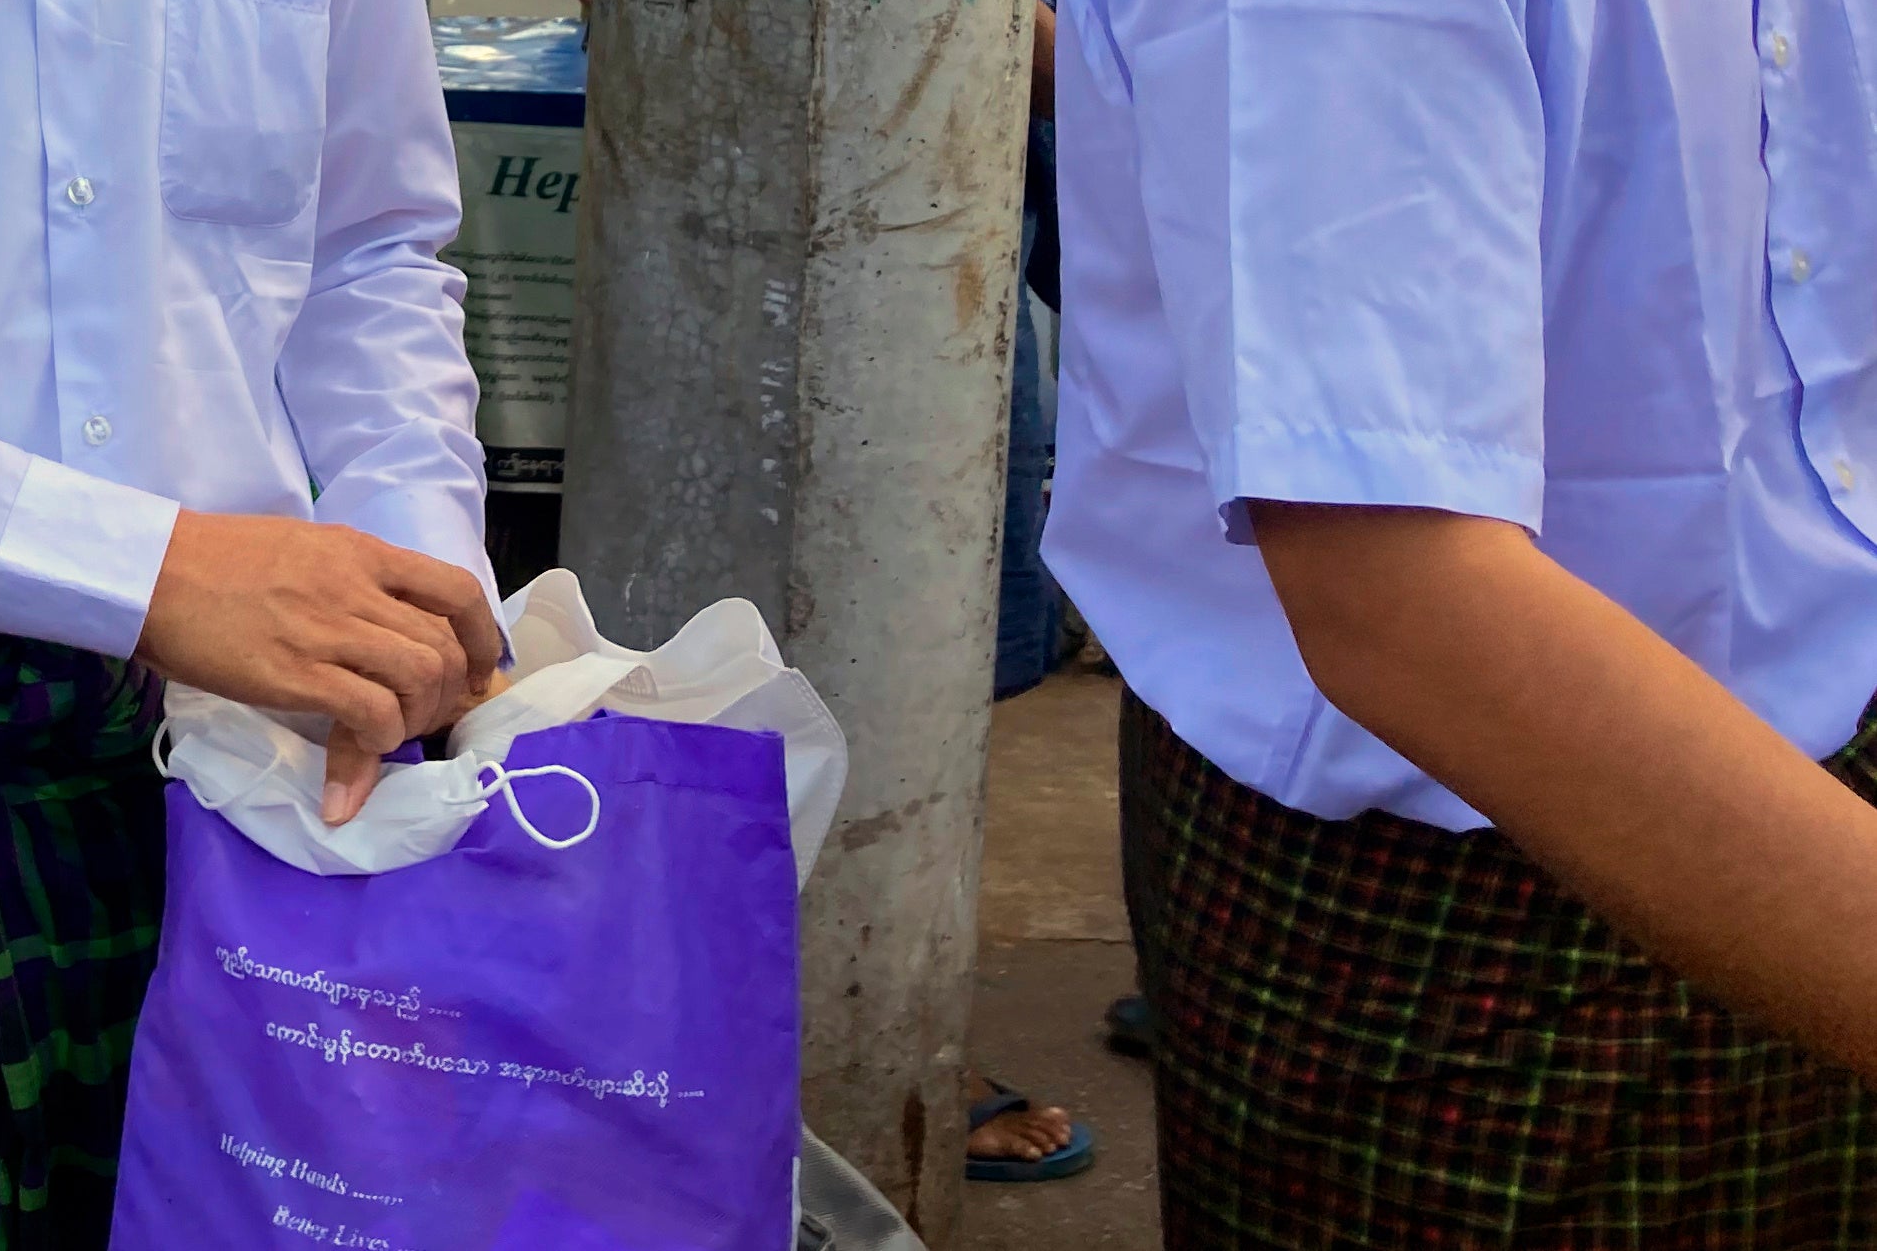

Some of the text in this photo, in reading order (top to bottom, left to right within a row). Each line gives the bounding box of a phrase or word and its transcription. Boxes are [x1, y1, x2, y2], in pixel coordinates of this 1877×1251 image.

[221, 1133, 349, 1196] Helping Hands
[273, 1204, 329, 1241] Better
